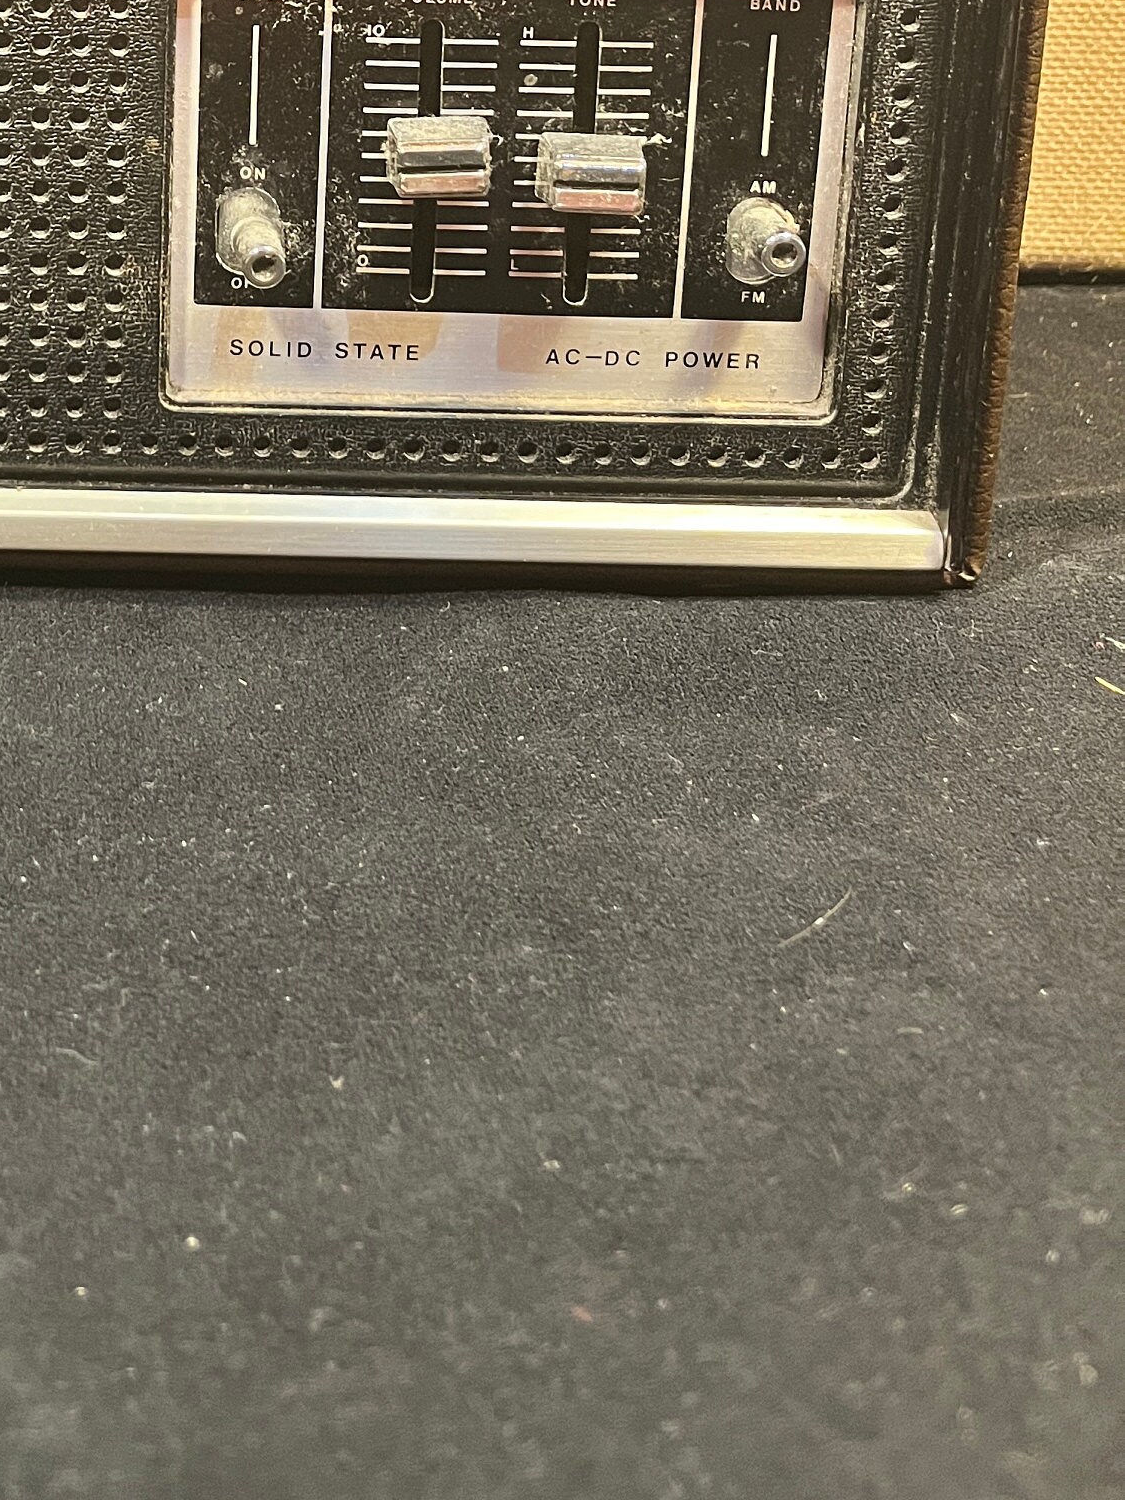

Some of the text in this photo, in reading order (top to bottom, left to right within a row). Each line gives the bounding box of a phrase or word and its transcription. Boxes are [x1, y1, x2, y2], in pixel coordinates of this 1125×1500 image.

[522, 26, 534, 39] H
[239, 166, 266, 180] ON
[750, 180, 777, 194] AM
[741, 291, 765, 304] FM
[229, 339, 420, 362] SOLID STATE
[665, 351, 761, 370] POWER
